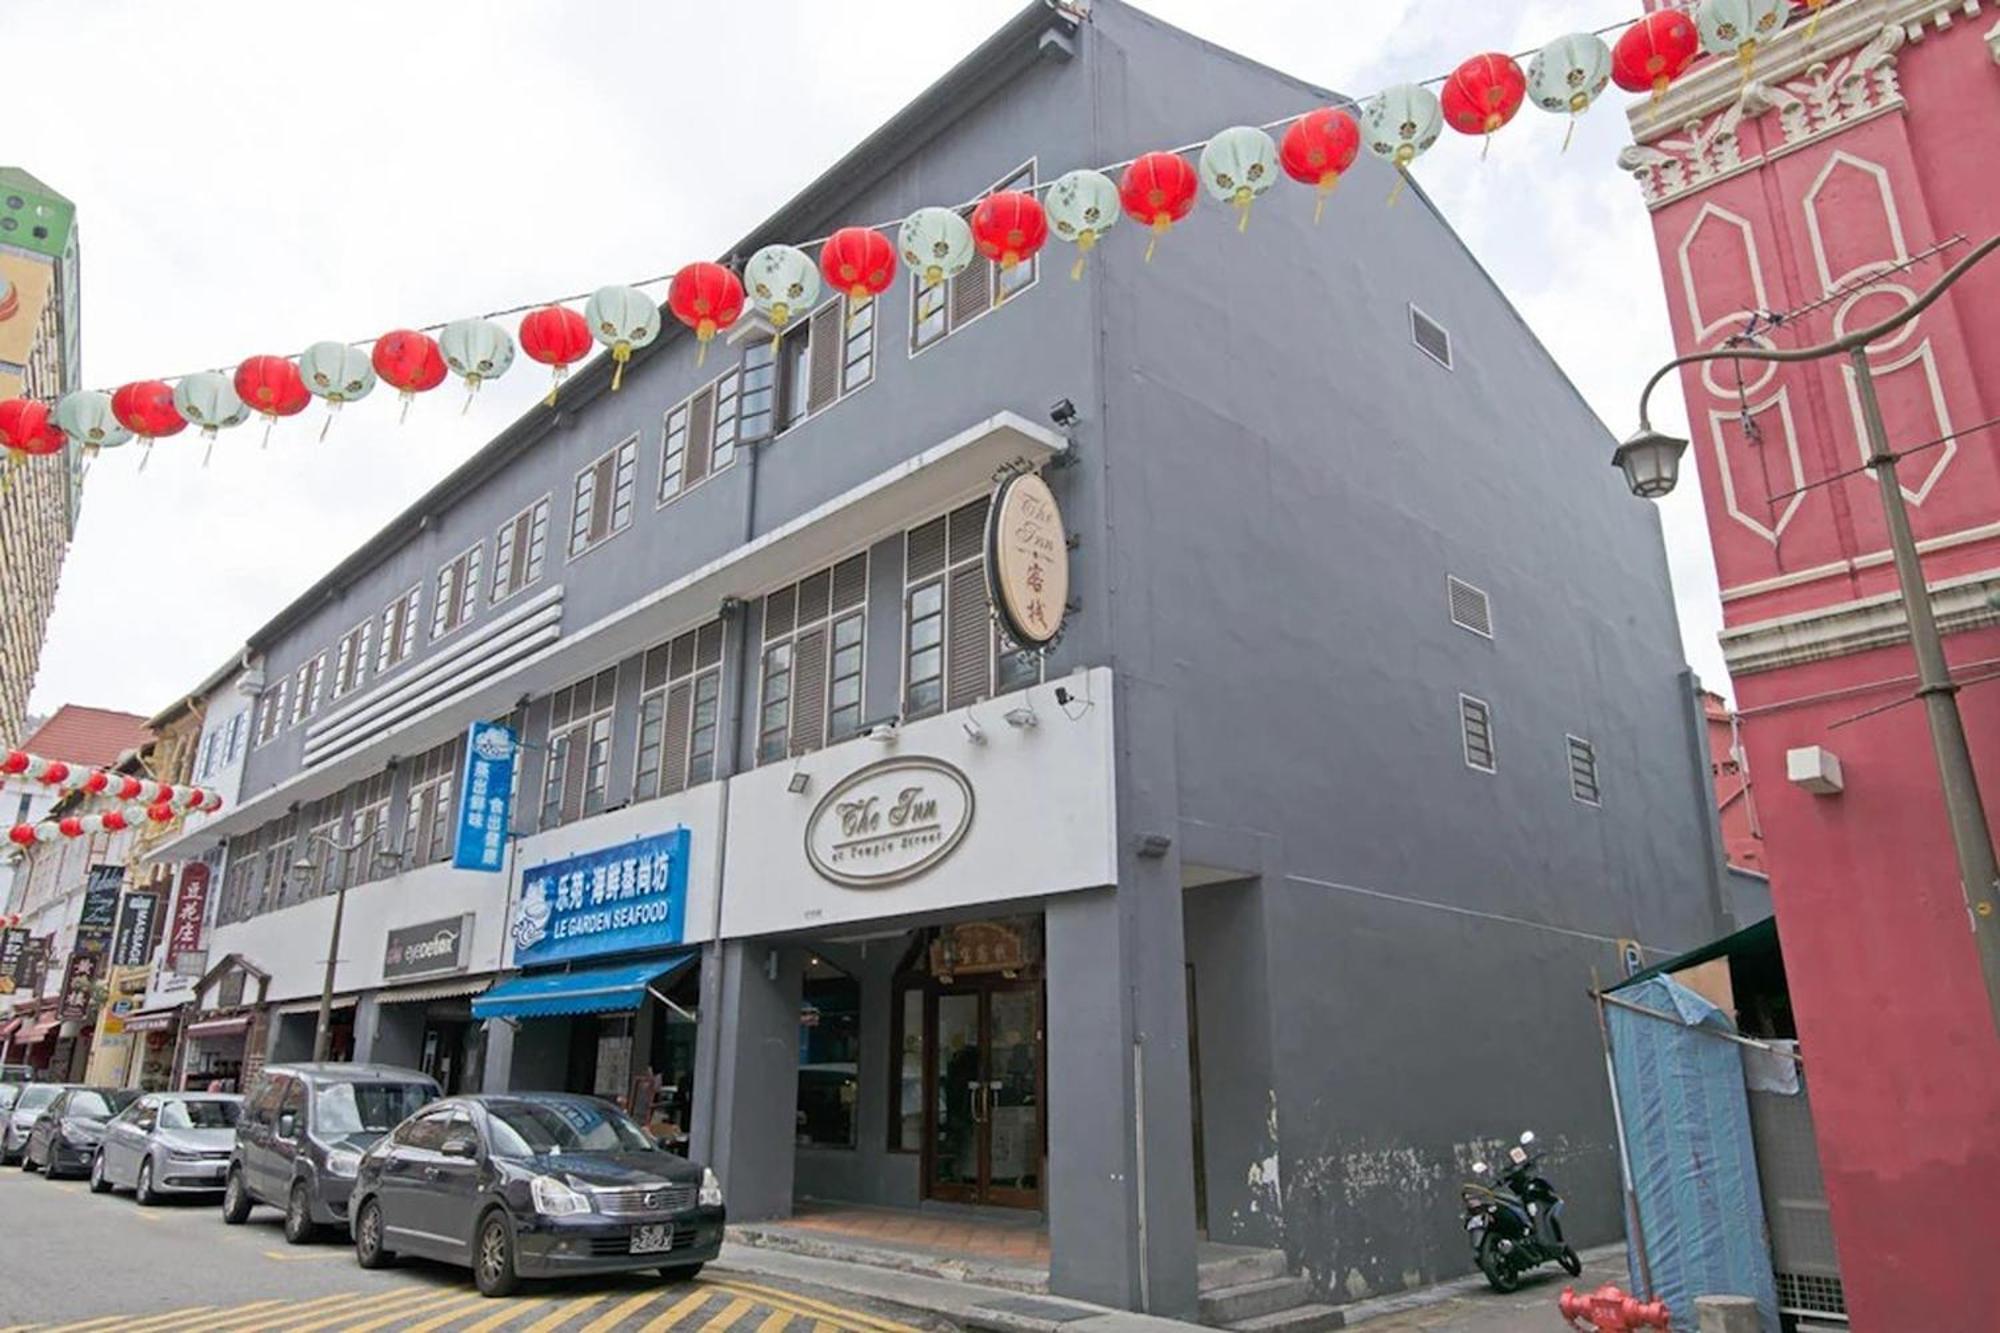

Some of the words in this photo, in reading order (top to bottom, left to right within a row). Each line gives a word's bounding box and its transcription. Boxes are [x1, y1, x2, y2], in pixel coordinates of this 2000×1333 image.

[1020, 493, 1053, 523] The
[1016, 521, 1054, 551] Inn
[836, 796, 880, 838] The
[888, 787, 937, 827] Inn
[850, 842, 894, 858] Temple
[901, 832, 942, 849] Street
[554, 919, 568, 939] LE
[568, 910, 611, 936] GARDEN
[613, 901, 668, 928] SEAFOOD
